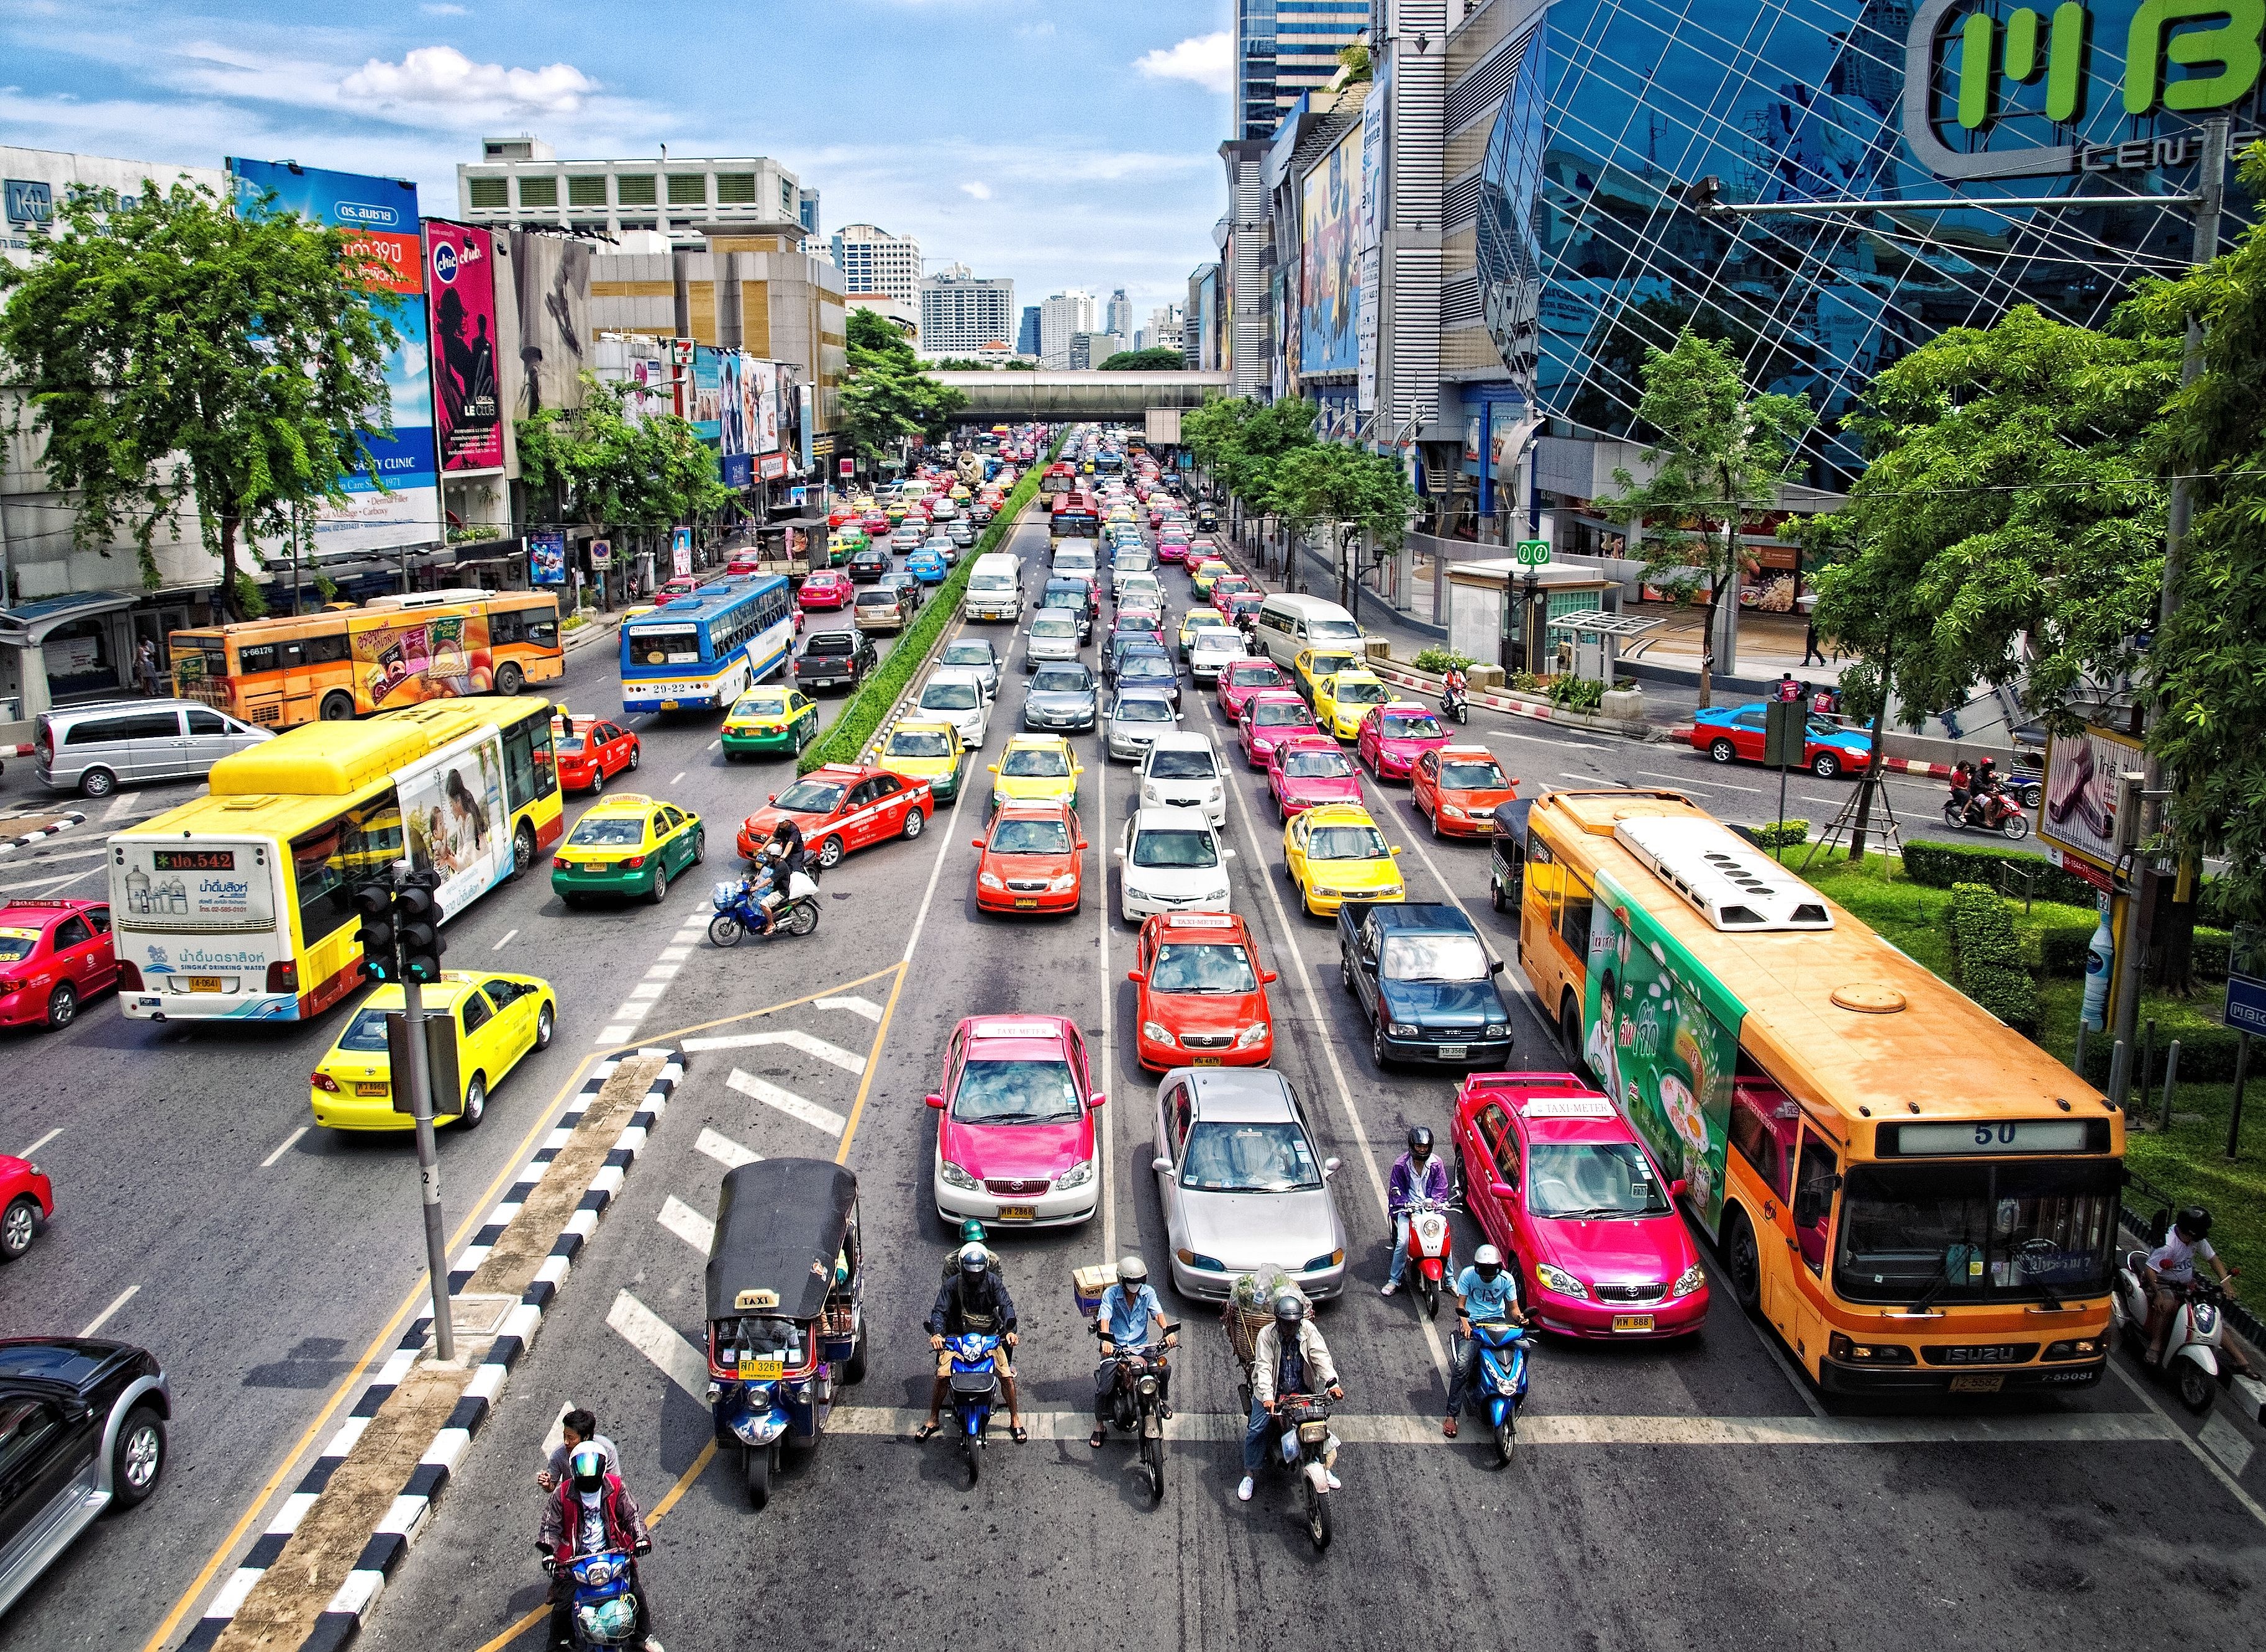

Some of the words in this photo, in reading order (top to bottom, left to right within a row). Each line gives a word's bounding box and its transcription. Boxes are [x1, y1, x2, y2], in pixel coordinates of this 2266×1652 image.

[438, 253, 456, 271] chic
[464, 405, 475, 416] LE
[476, 404, 495, 415] CLUB
[384, 456, 416, 470] CLINIC
[347, 479, 363, 489] Care
[385, 477, 401, 488] 1971
[362, 506, 388, 517] Carboxy
[653, 683, 685, 694] 29-22
[199, 879, 248, 892] น้ำดื่มสิงห์
[180, 948, 265, 963] น้ำดื่มตราสิงห์
[2233, 1004, 2266, 1023] MBK
[1545, 1103, 1608, 1113] TAXI-METER
[1975, 1123, 2016, 1145] 50
[422, 1171, 430, 1184] 2
[743, 1297, 768, 1305] TAXI
[1633, 1317, 1649, 1326] 888
[1945, 1347, 2014, 1361] ISUZU
